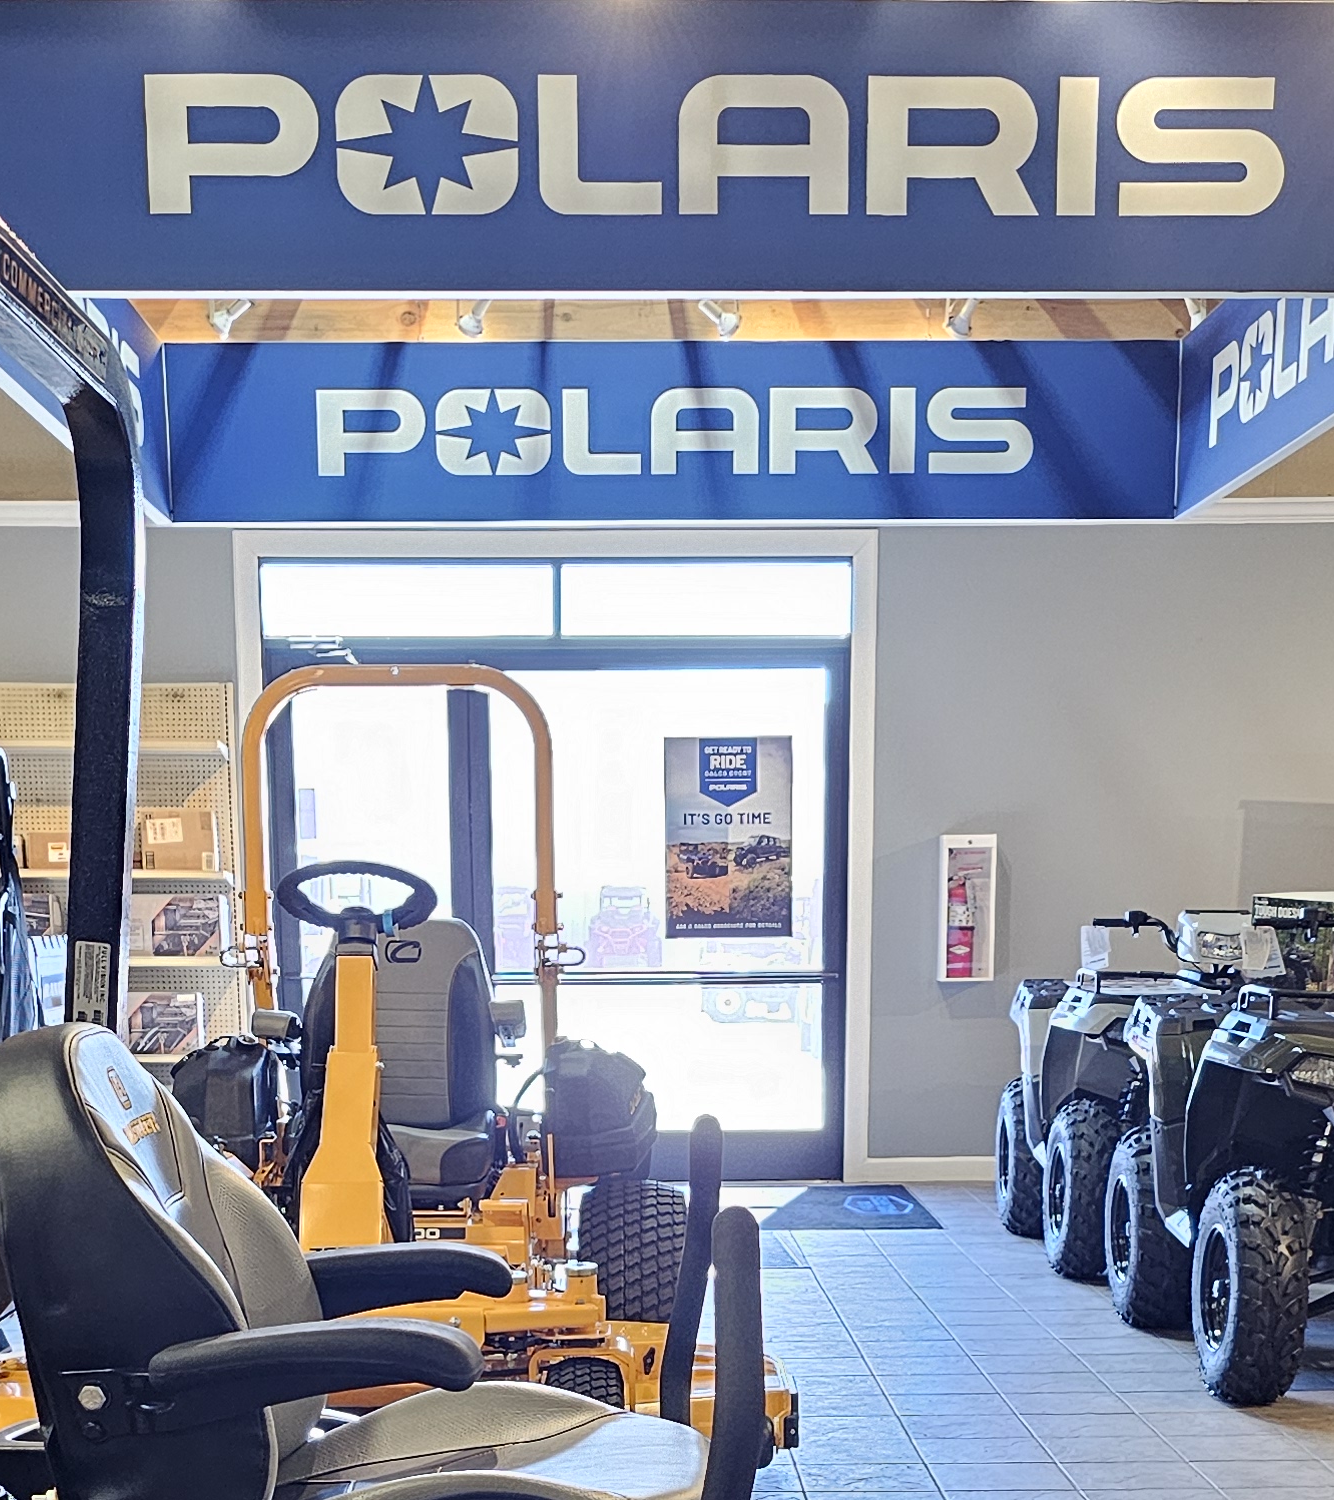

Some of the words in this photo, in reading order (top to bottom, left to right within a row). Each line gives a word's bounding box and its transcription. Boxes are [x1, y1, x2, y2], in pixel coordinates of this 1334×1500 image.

[144, 73, 1287, 216] POLARIS
[315, 387, 1035, 478] POLARIS
[710, 754, 746, 769] RIDE
[683, 813, 710, 825] IT'S
[714, 813, 733, 825] GO
[737, 812, 771, 825] TIME
